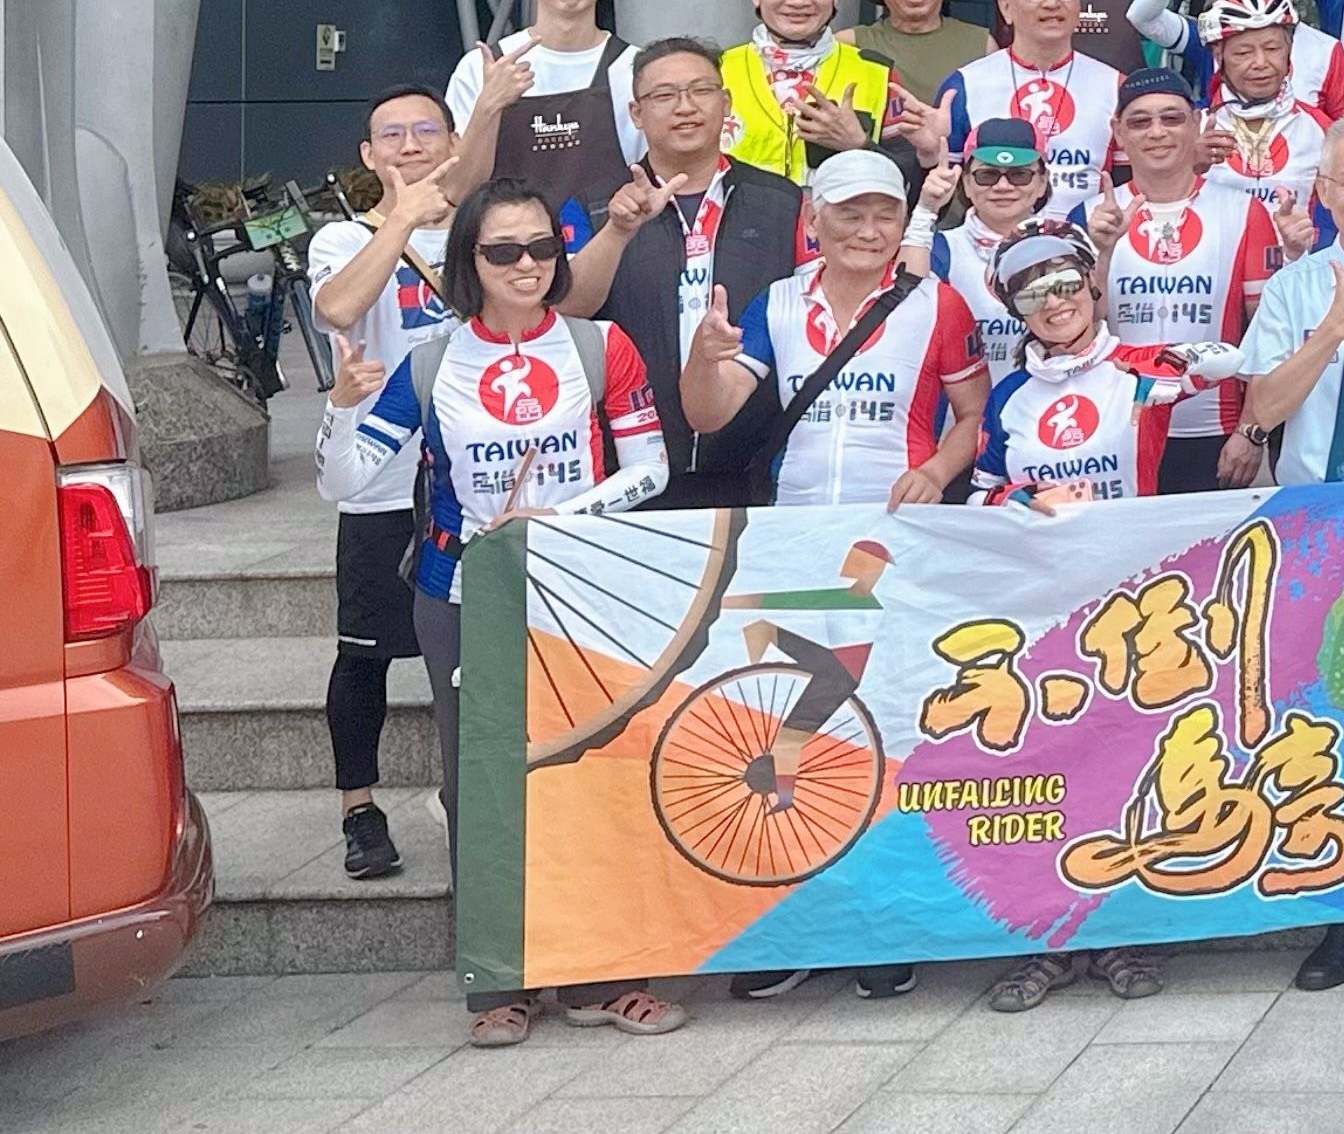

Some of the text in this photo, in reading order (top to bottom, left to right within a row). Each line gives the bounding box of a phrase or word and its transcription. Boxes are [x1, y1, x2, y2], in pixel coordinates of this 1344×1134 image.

[1116, 275, 1212, 295] TAIWAN
[1022, 454, 1119, 482] TAIWAN
[898, 773, 1067, 815] UNFAILING
[967, 810, 1067, 847] RIDER
